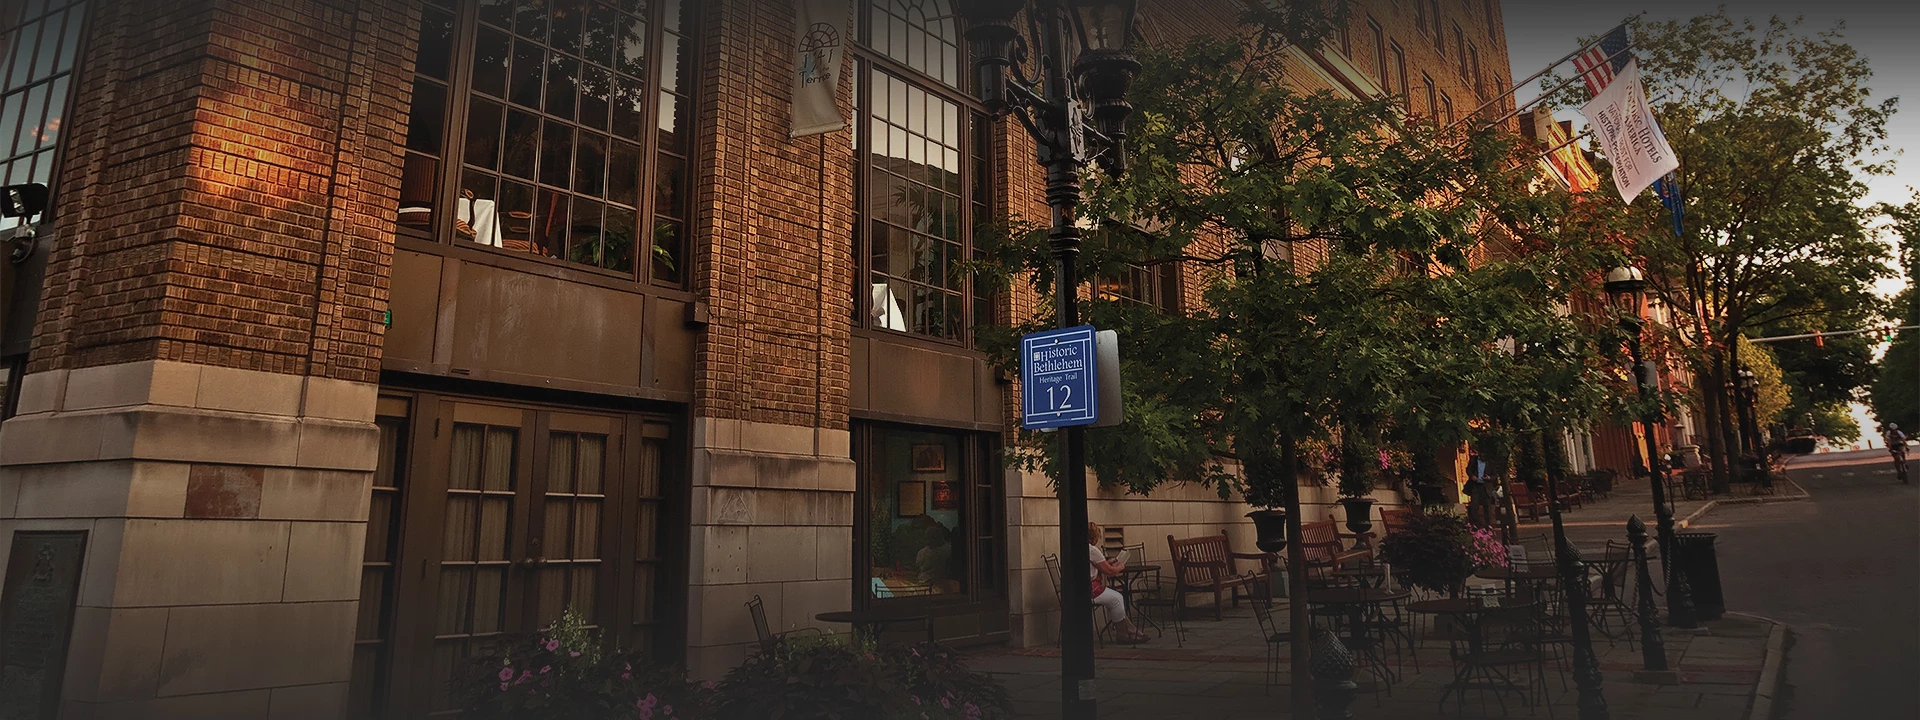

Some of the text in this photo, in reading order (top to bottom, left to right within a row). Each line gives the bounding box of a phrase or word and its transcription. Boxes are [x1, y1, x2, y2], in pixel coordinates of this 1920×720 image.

[1639, 126, 1662, 164] HOTELS
[1624, 159, 1633, 171] FOR
[1040, 345, 1078, 362] Historic
[1034, 359, 1083, 373] Bethlehem
[1039, 372, 1078, 384] Heritage Trail
[1046, 384, 1072, 410] 12
